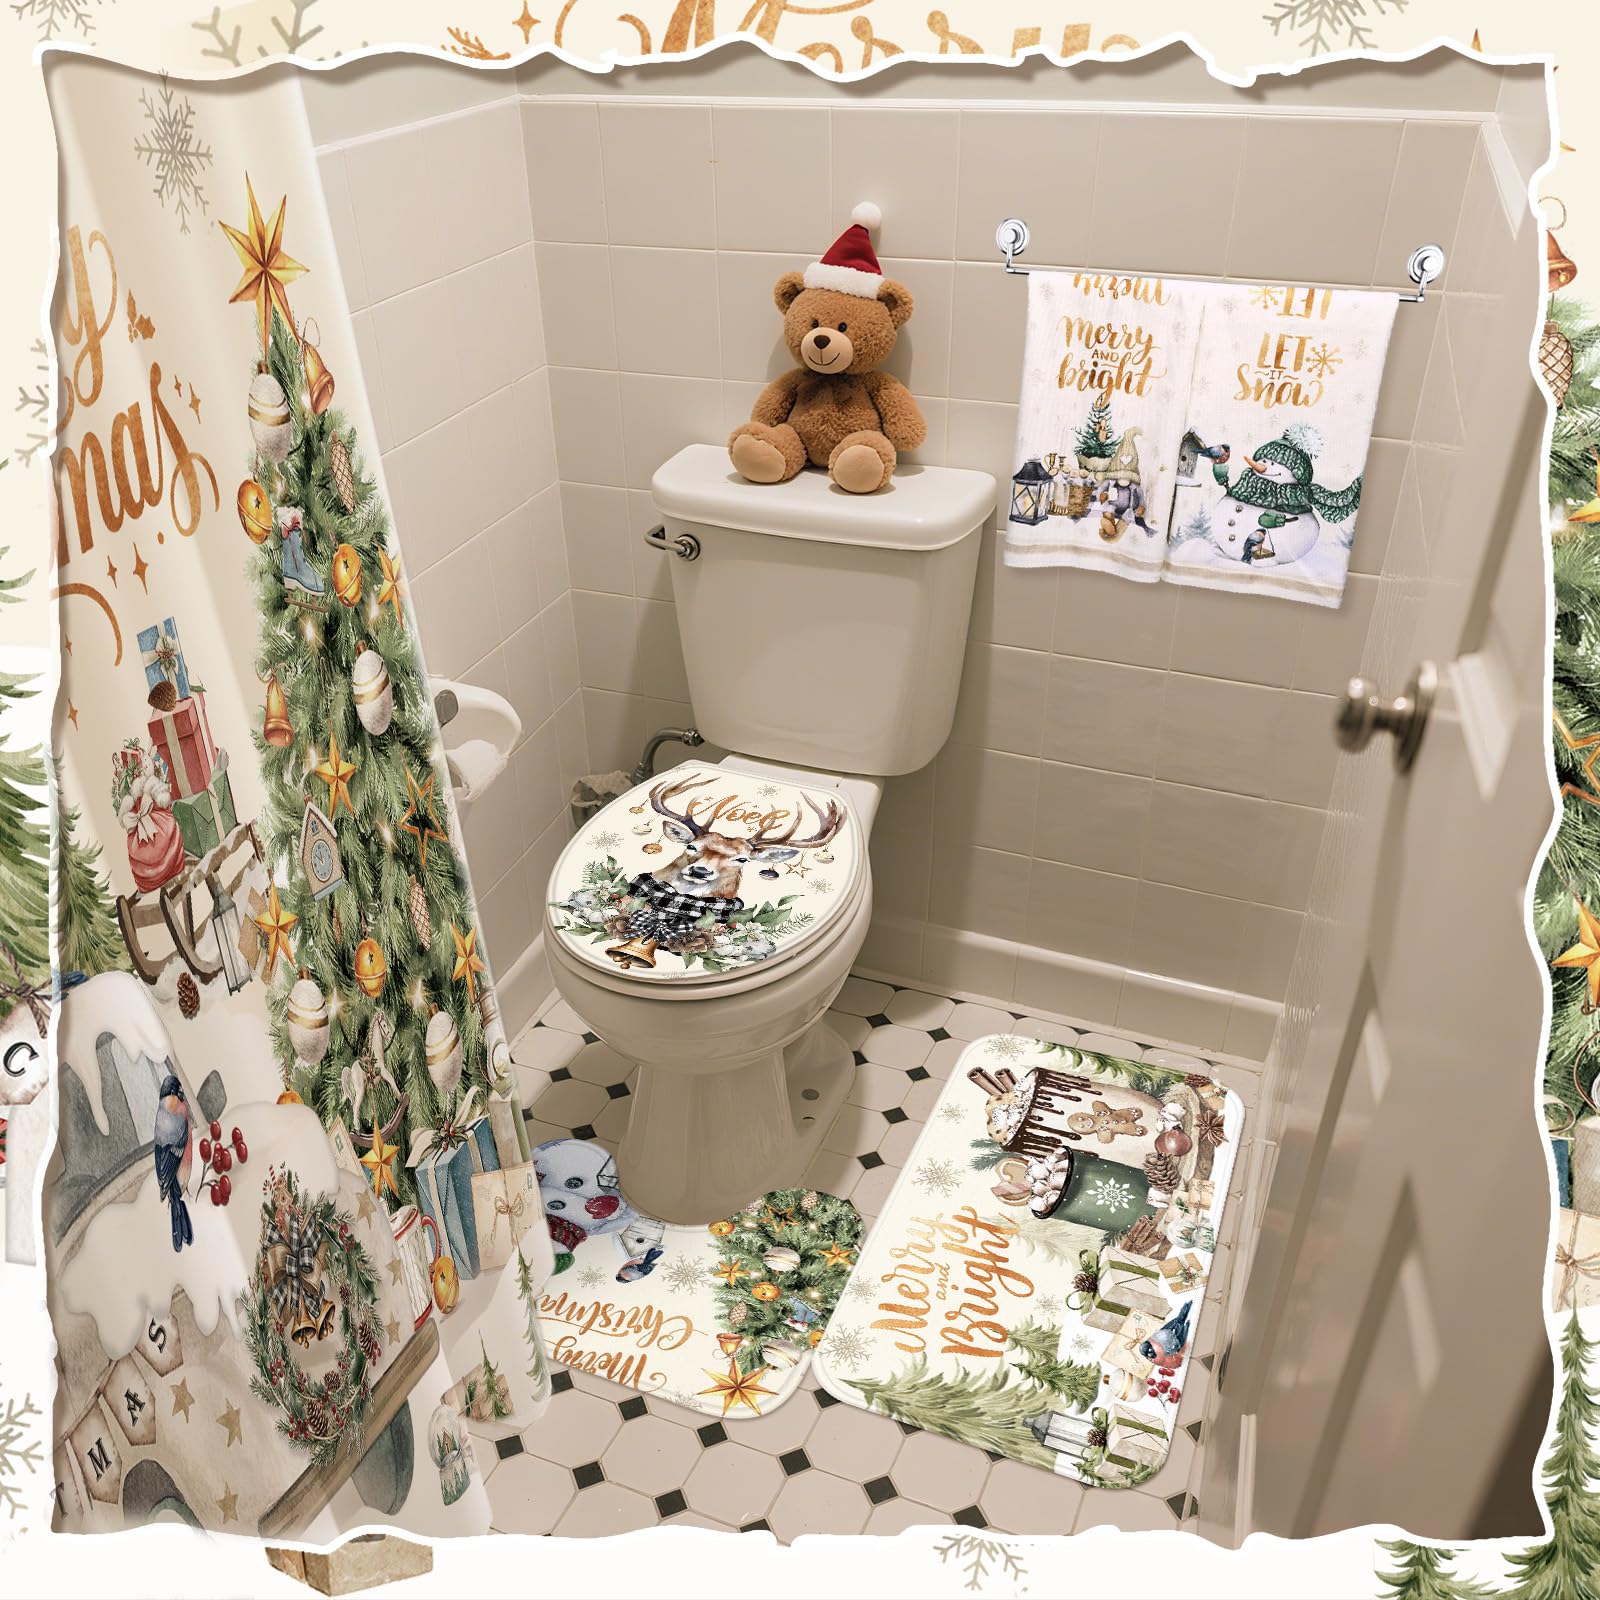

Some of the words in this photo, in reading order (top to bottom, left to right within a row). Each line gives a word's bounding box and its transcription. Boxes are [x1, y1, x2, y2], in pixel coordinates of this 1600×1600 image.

[1056, 315, 1160, 365] Merry
[1091, 349, 1119, 363] AND
[1256, 331, 1313, 372] LET
[1056, 352, 1168, 409] bright
[1233, 363, 1324, 409] Snow
[1269, 370, 1284, 381] IT
[687, 795, 790, 831] Noel
[870, 1212, 969, 1354] Merry
[936, 1262, 951, 1300] and
[941, 1205, 1035, 1358] Bright
[537, 1291, 706, 1351] Christma
[545, 1335, 667, 1392] Merry
